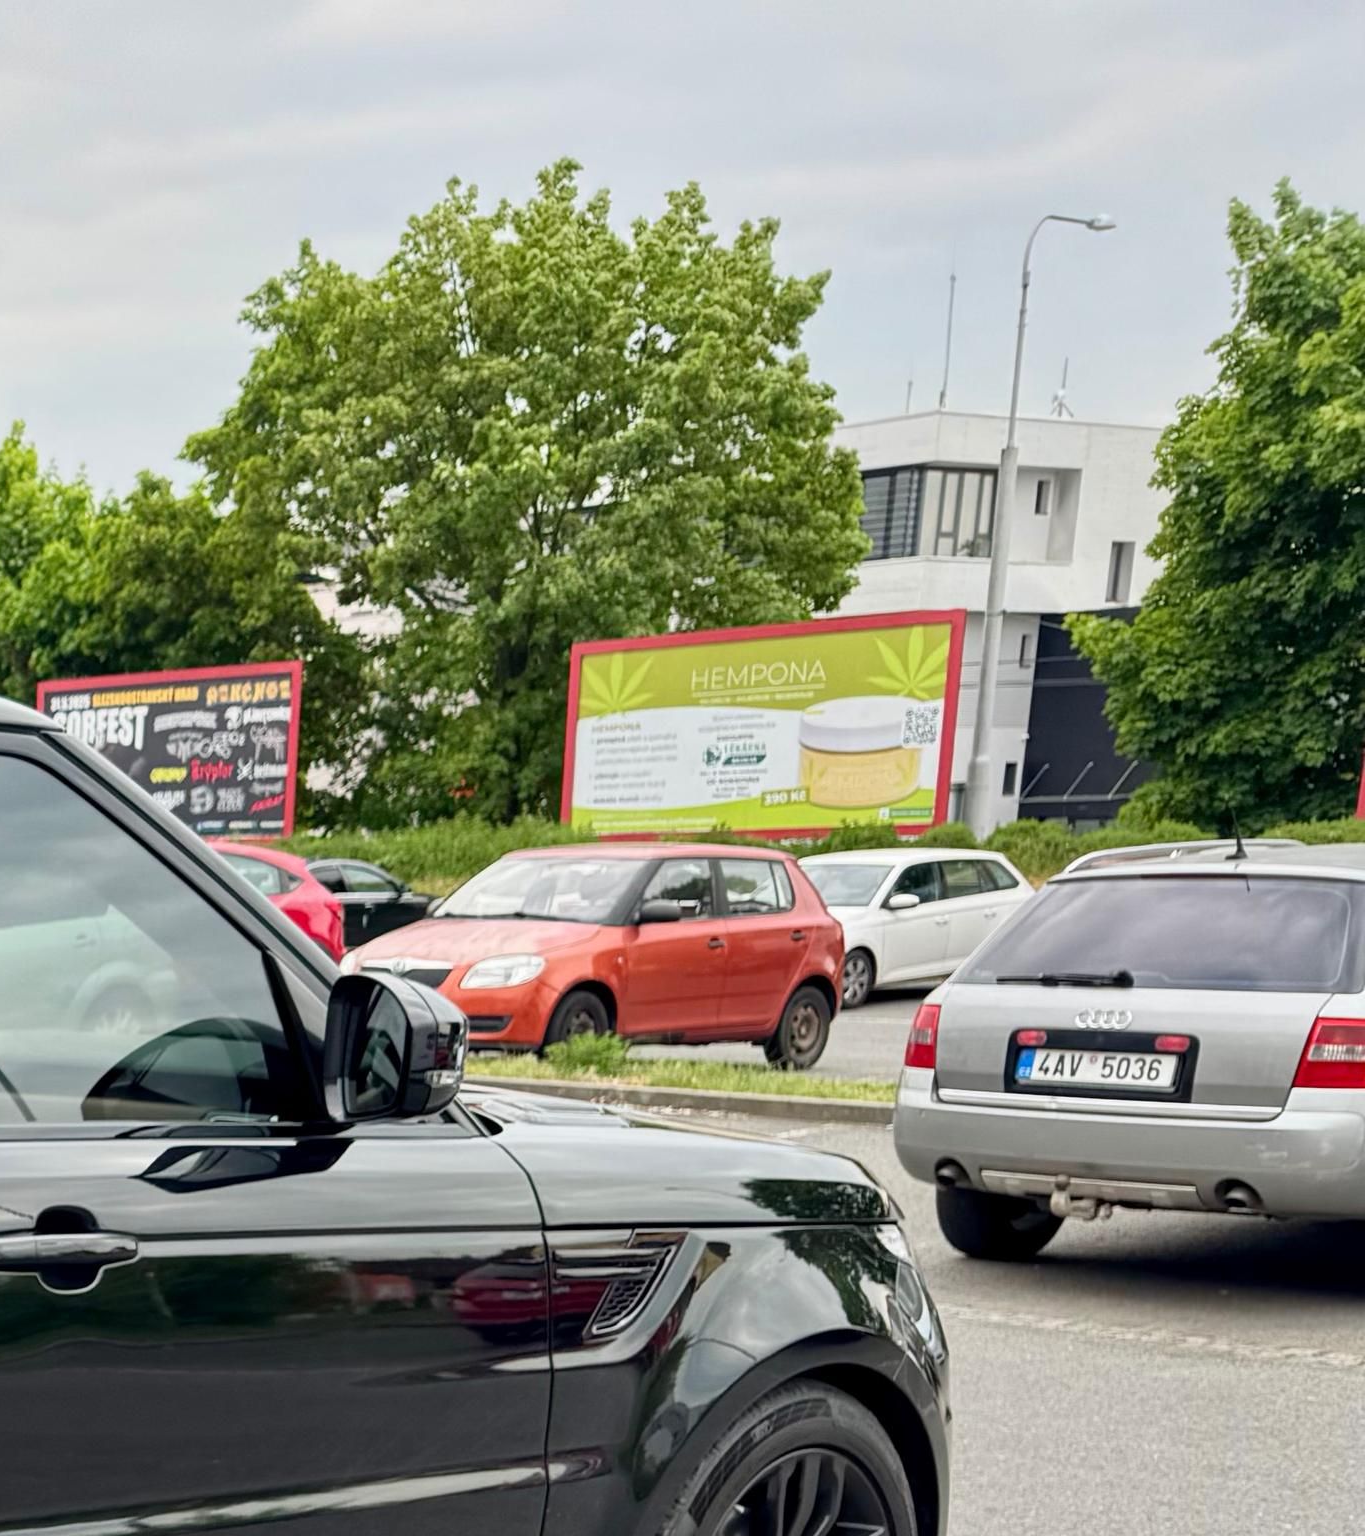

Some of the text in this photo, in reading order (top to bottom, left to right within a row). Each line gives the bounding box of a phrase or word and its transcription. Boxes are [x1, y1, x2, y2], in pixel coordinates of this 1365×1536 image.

[691, 659, 827, 690] HEMPONA
[1038, 1053, 1084, 1077] 4AV
[1101, 1055, 1163, 1081] 5036
